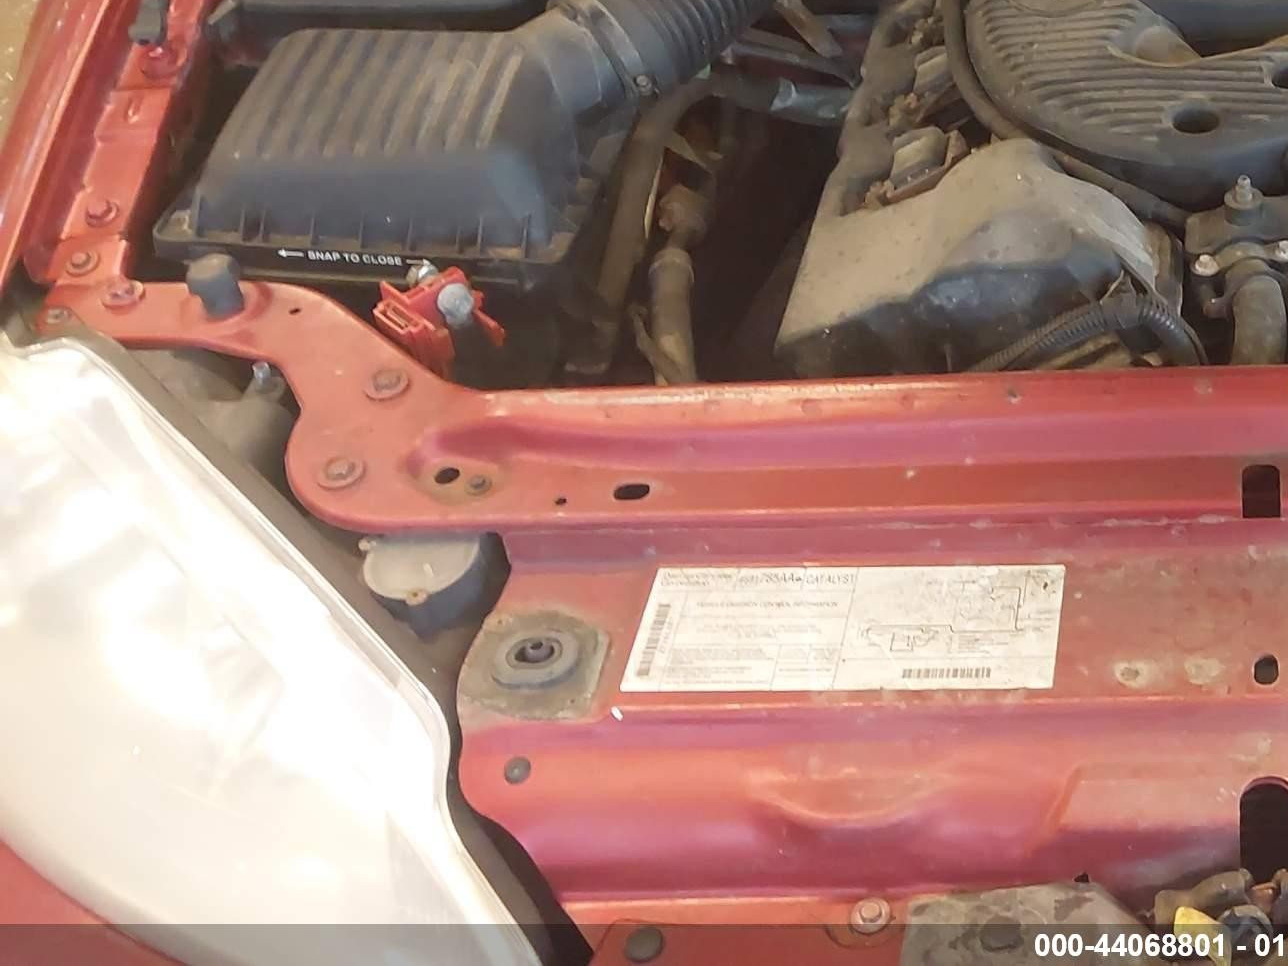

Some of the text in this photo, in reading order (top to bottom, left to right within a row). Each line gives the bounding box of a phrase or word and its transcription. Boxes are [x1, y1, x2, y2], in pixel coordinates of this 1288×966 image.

[307, 249, 403, 266] SNAP TO CLOSE
